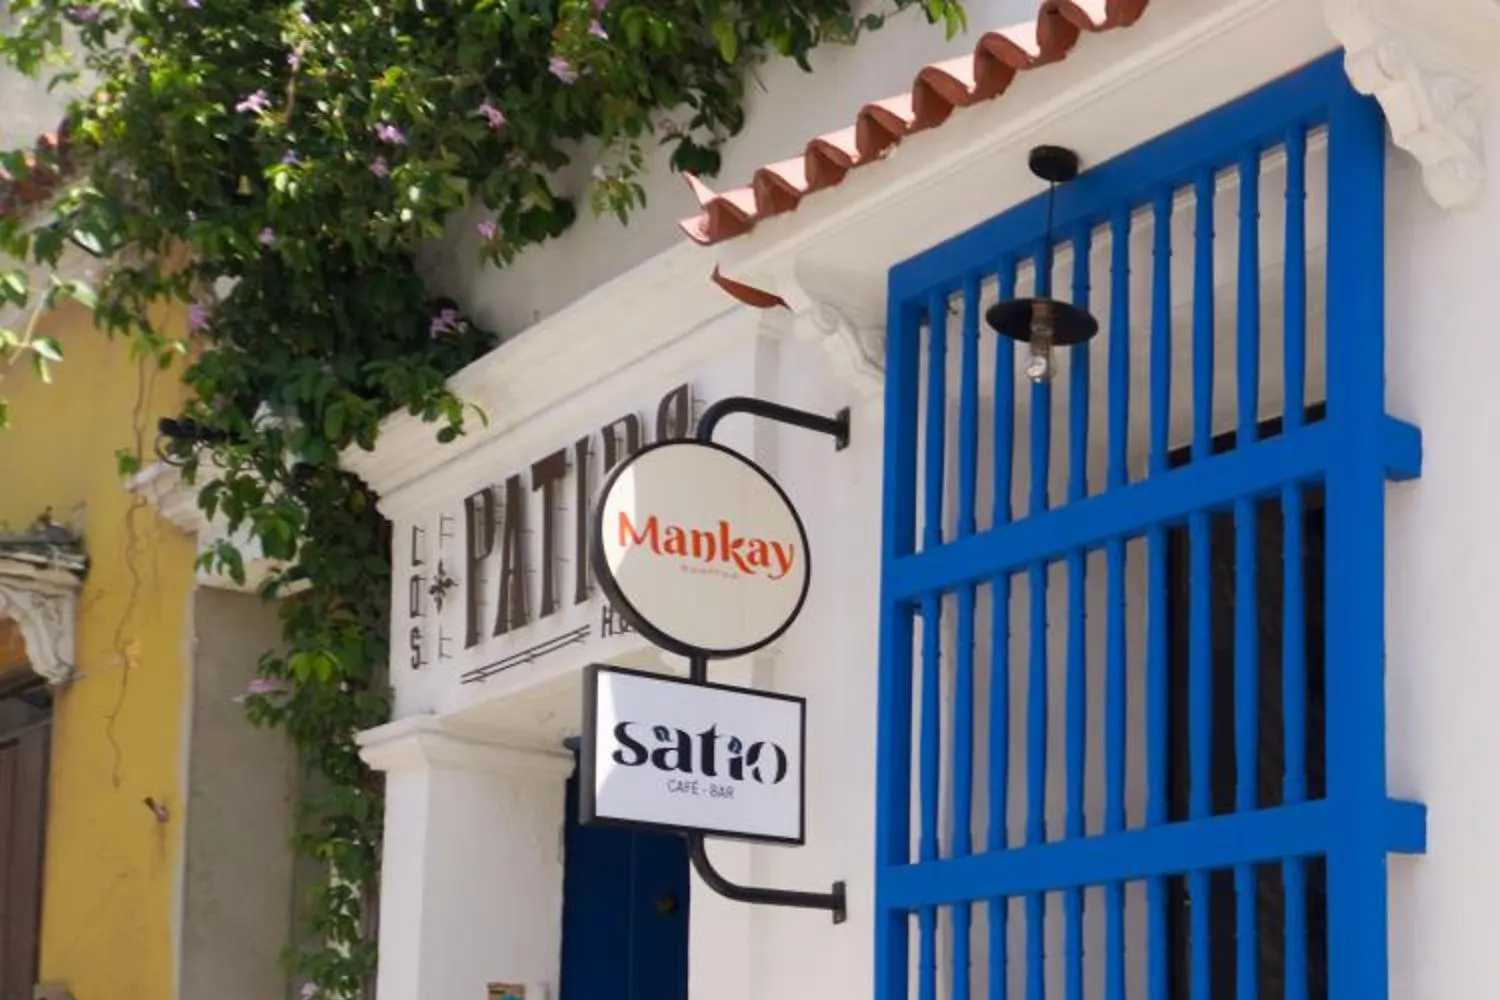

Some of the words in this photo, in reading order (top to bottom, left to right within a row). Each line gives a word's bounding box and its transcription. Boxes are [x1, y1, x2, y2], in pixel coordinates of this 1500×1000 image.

[464, 384, 690, 649] PATI
[618, 511, 796, 580] Mankay
[709, 783, 735, 799] BAR
